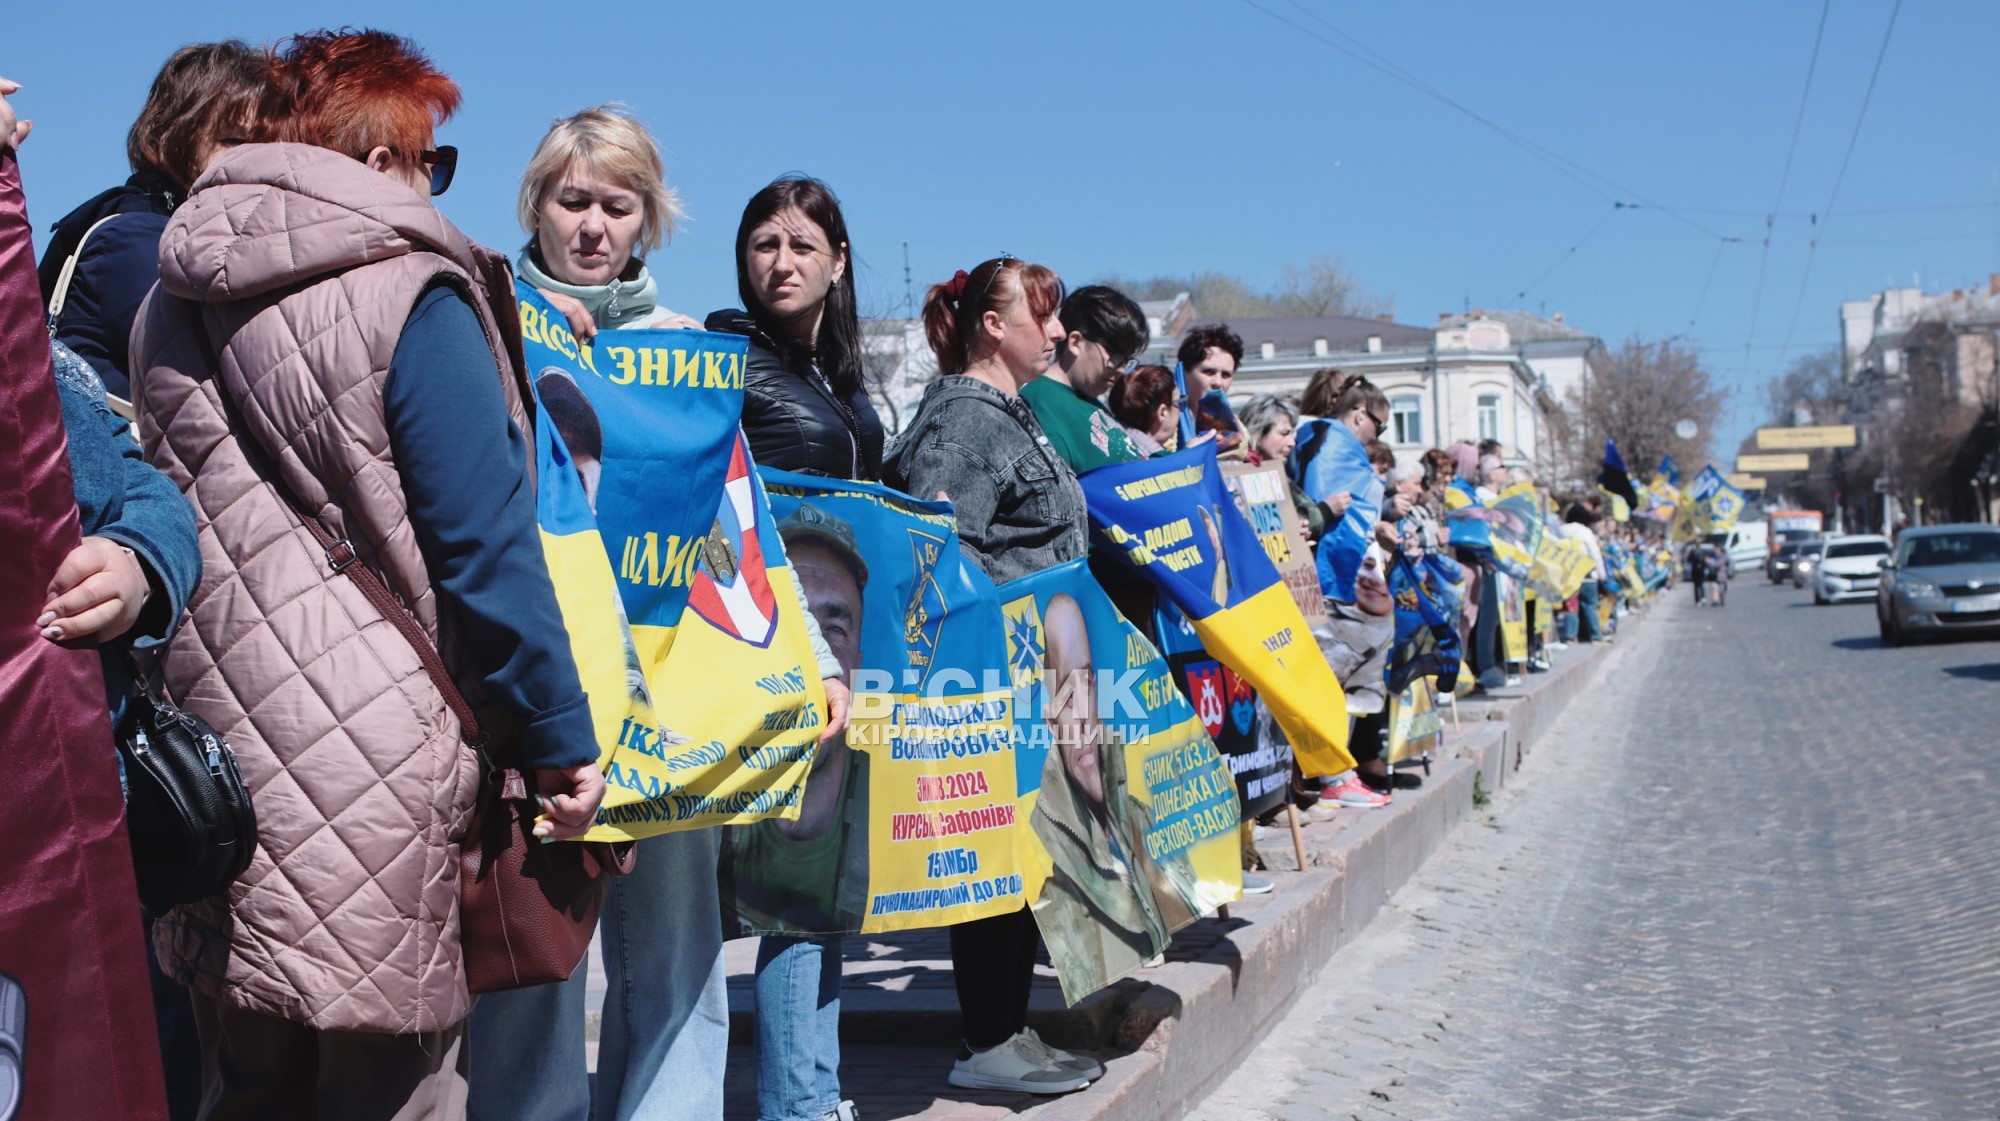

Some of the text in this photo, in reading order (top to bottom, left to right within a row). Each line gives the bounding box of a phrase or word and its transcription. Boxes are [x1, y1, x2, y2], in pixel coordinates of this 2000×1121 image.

[1145, 754, 1175, 788] ЗНИК
[972, 880, 994, 903] ДО
[994, 876, 1008, 897] 82
